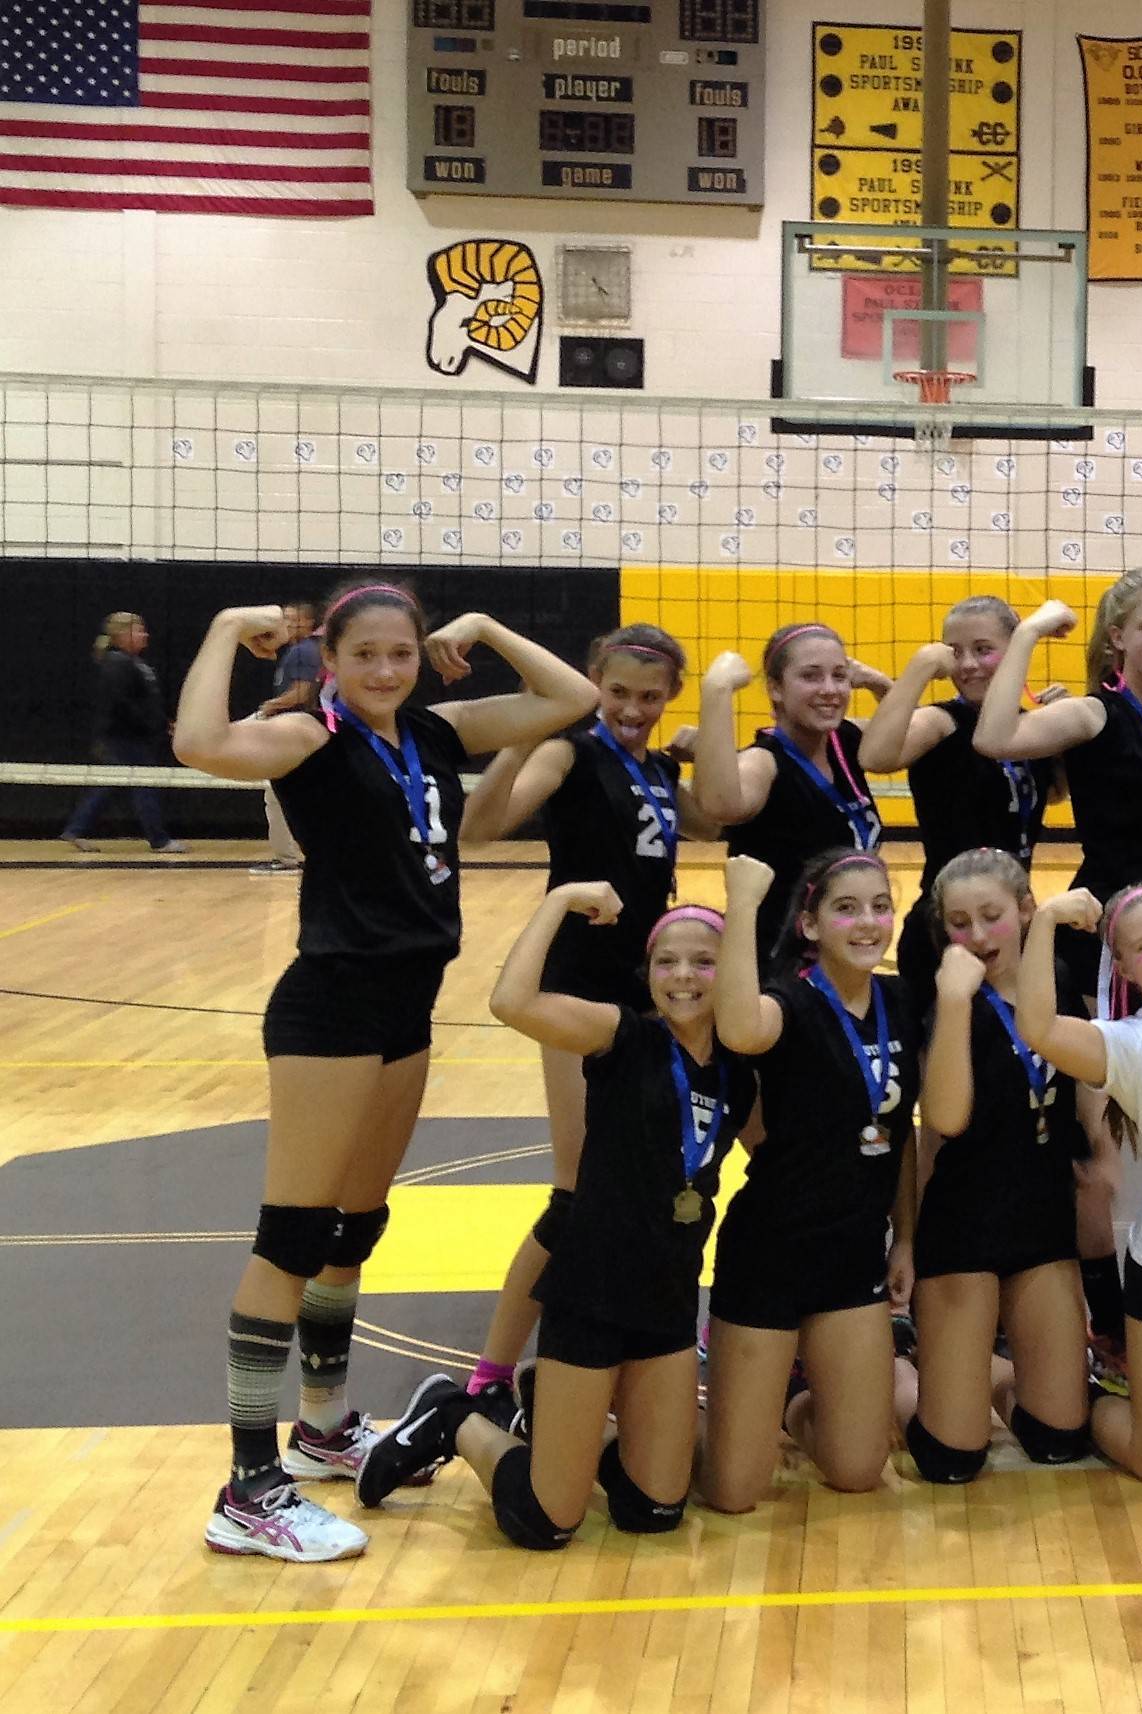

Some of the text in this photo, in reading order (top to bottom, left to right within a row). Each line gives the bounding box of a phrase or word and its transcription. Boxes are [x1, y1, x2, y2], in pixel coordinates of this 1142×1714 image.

[553, 37, 622, 60] period
[860, 54, 897, 71] PAUL
[554, 75, 621, 101] player
[435, 159, 476, 180] won
[561, 165, 613, 188] game
[698, 170, 738, 189] won
[858, 177, 896, 194] PAUL
